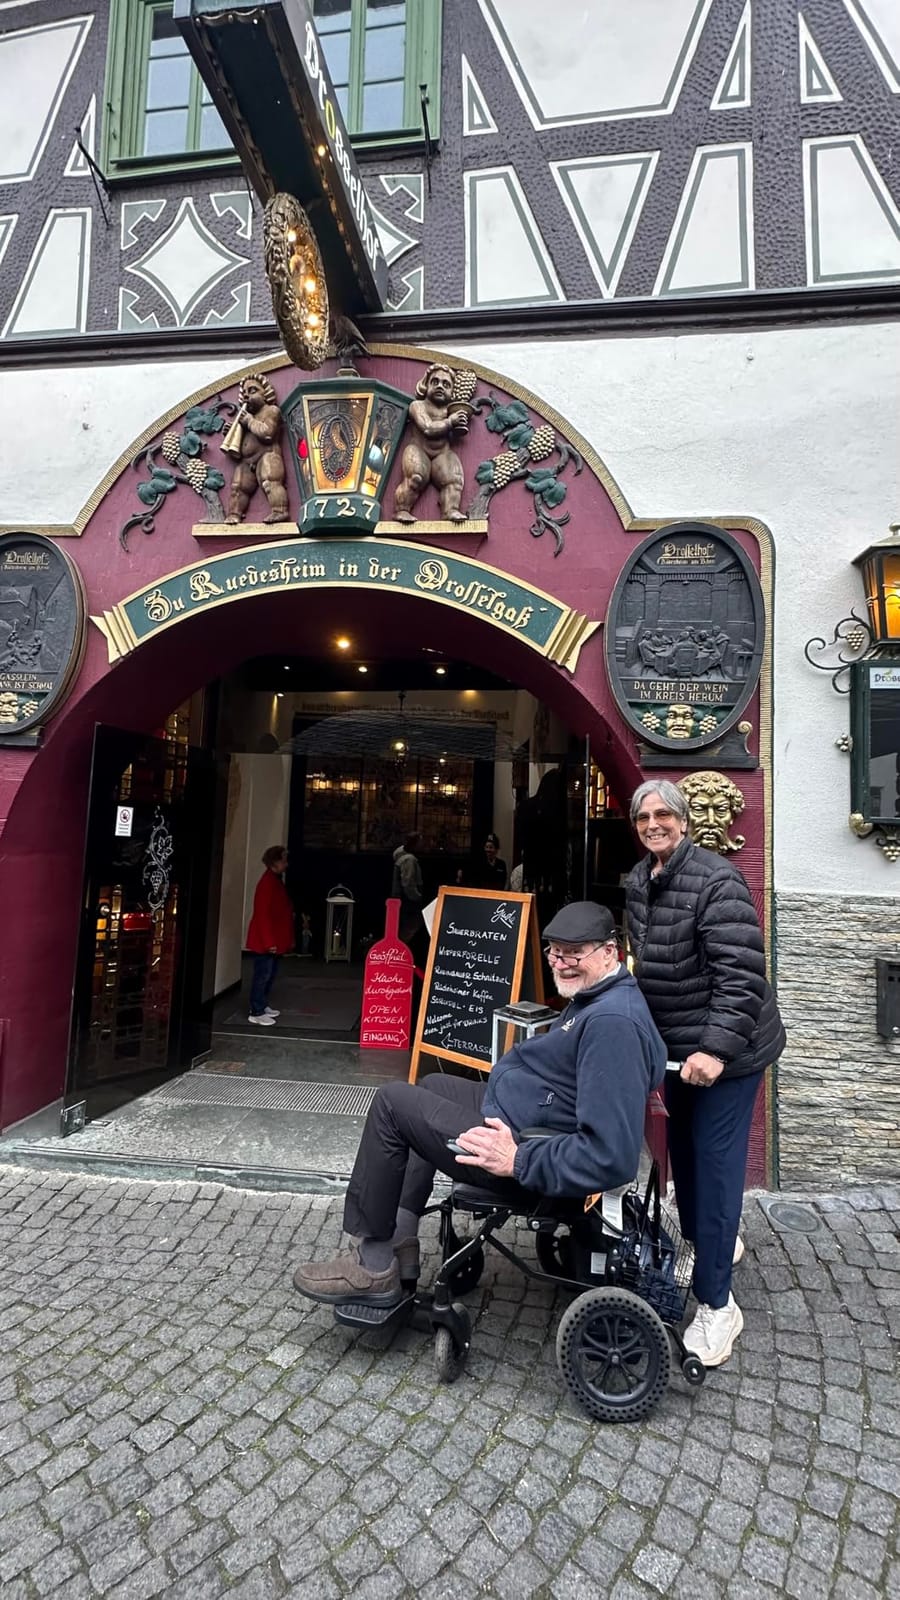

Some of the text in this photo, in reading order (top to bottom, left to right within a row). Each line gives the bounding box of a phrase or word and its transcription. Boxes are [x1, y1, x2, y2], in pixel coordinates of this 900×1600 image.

[302, 498, 376, 523] 1727
[143, 589, 186, 622] Zu
[190, 557, 326, 602] Ruedesheim
[338, 559, 359, 577] in
[368, 557, 402, 581] der
[14, 681, 26, 689] IST
[634, 681, 729, 693] DA GEHT DER WEIN
[640, 690, 723, 702] IM KREIS HERUM
[369, 1004, 401, 1015] OPEN
[363, 1015, 407, 1025] KITCHEN
[362, 1033, 400, 1043] EINGANG
